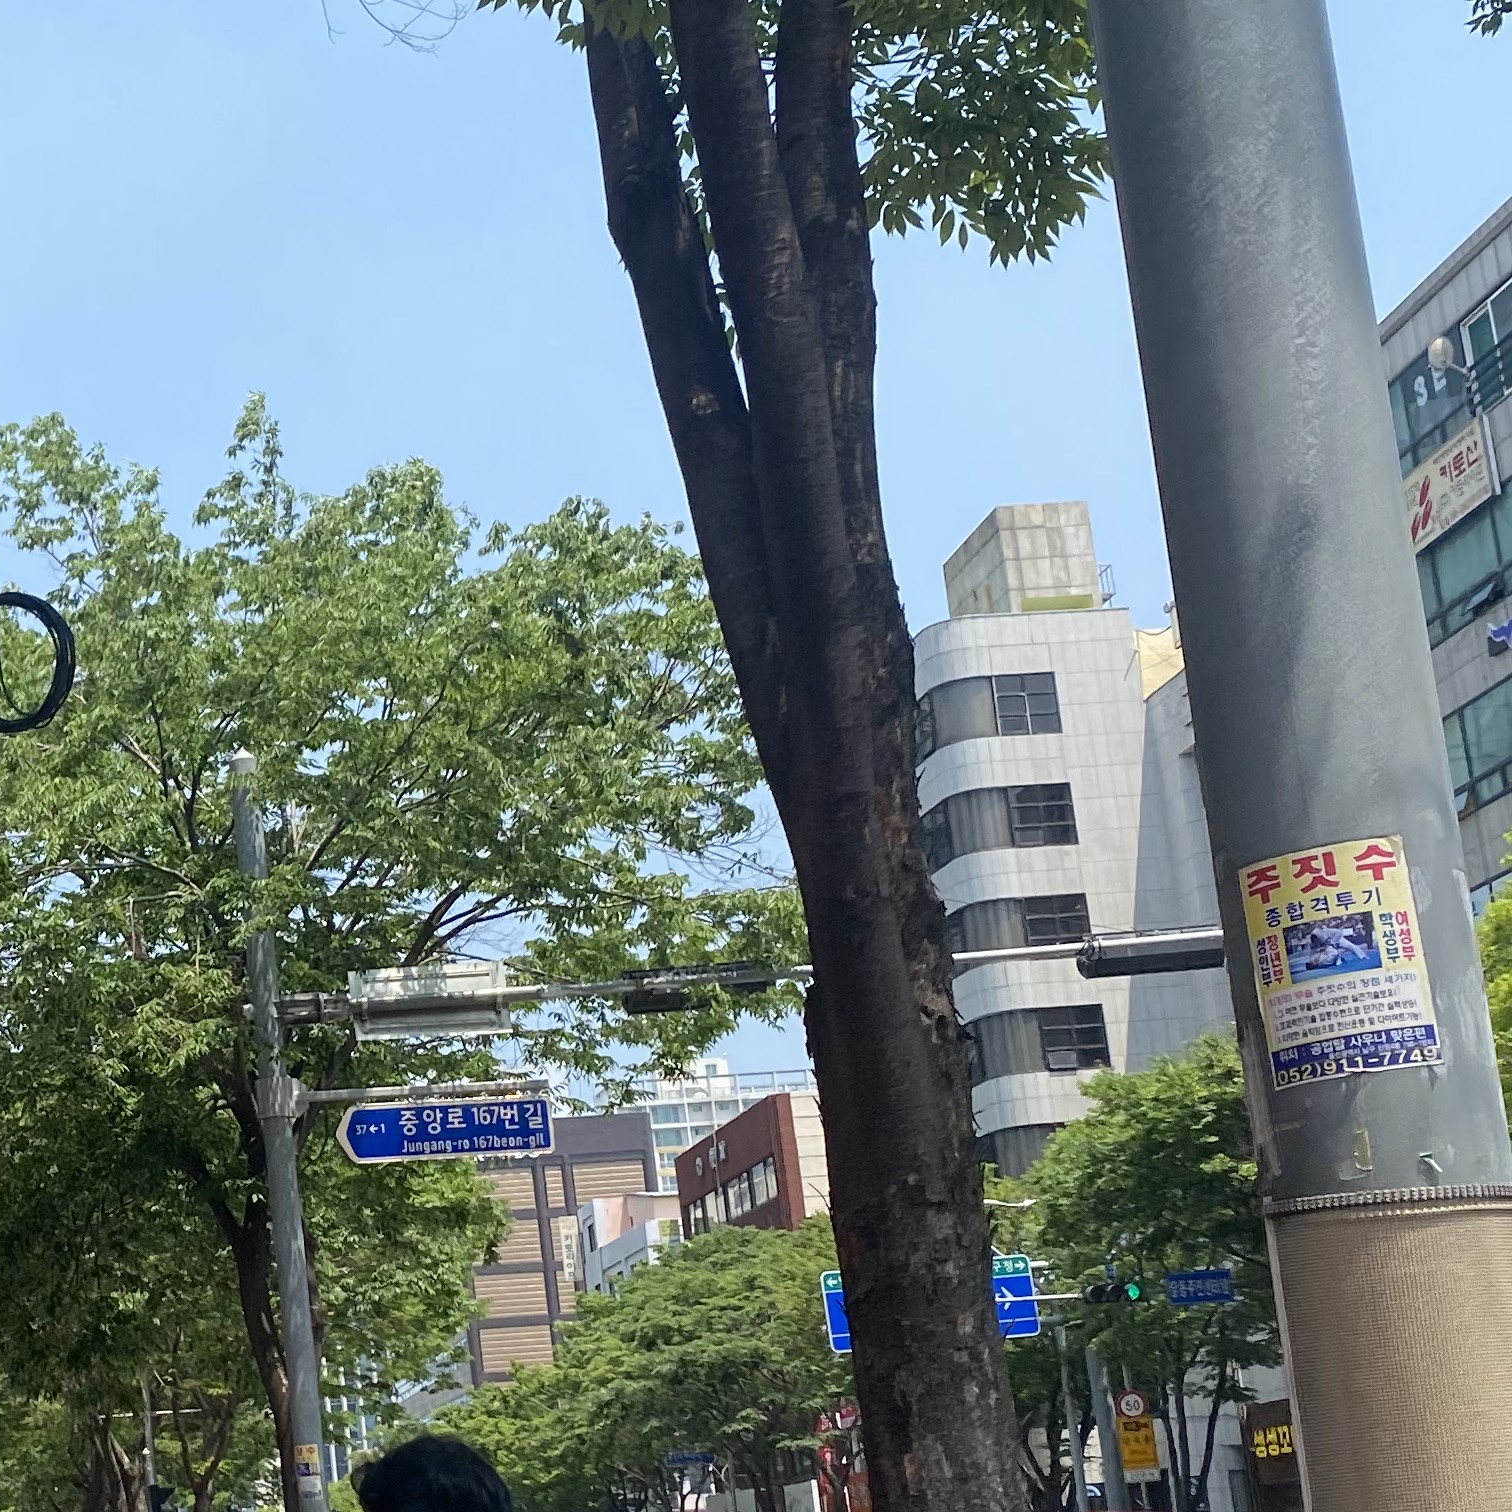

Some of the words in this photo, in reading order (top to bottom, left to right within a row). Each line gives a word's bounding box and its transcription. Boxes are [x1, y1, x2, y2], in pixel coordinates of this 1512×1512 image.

[1246, 844, 1397, 905] 주짓수
[1264, 886, 1382, 928] 종합격투기
[1379, 911, 1398, 963] 학생부
[1395, 910, 1416, 961] 여성부
[1349, 1032, 1386, 1049] 사우나
[399, 1107, 467, 1136] 중앙로
[471, 1103, 543, 1130] 167번길
[401, 1137, 469, 1154] Jungang-ro
[472, 1133, 545, 1149] 167beon-gil
